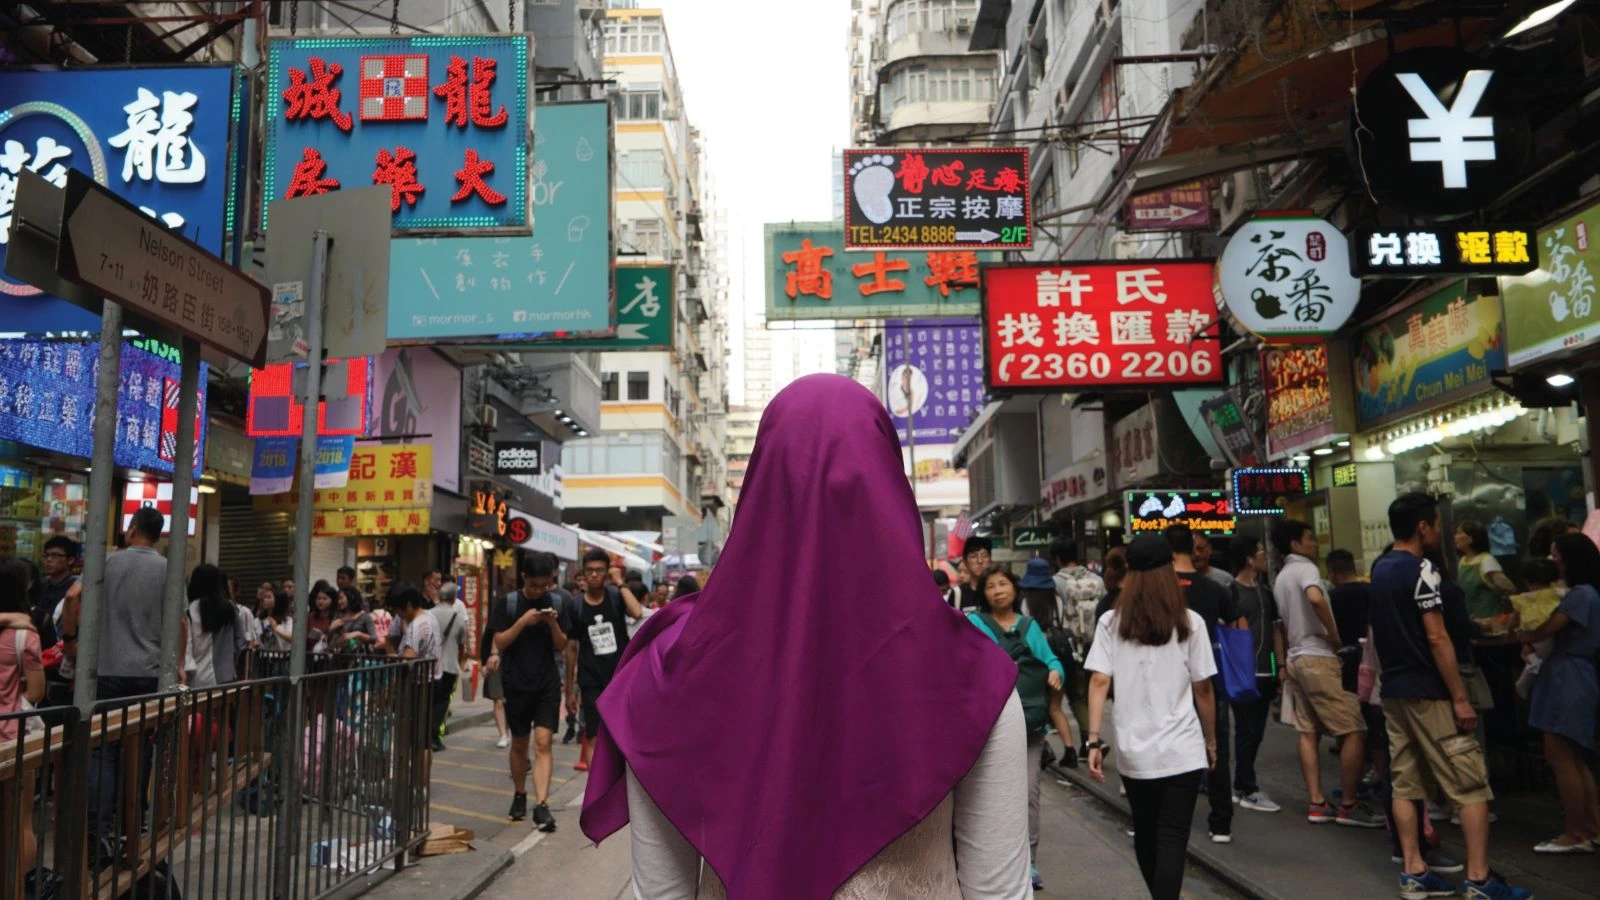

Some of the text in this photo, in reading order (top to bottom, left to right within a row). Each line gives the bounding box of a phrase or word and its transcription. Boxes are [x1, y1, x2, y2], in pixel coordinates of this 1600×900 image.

[108, 87, 206, 183] 龍
[1395, 69, 1495, 188] ¥
[895, 195, 1025, 219] 正宗按摩
[920, 225, 956, 243] 8886
[1001, 226, 1028, 243] 2/F
[139, 226, 226, 295] Nelson Street
[141, 270, 217, 334] 奶路臣街
[620, 276, 661, 318] 店
[1036, 269, 1168, 307] 許氏
[997, 309, 1211, 348] 找換匯款
[1021, 350, 1213, 379] 2360 2206
[498, 448, 537, 458] adidas
[498, 458, 537, 469] football
[1015, 531, 1054, 545] Clark
